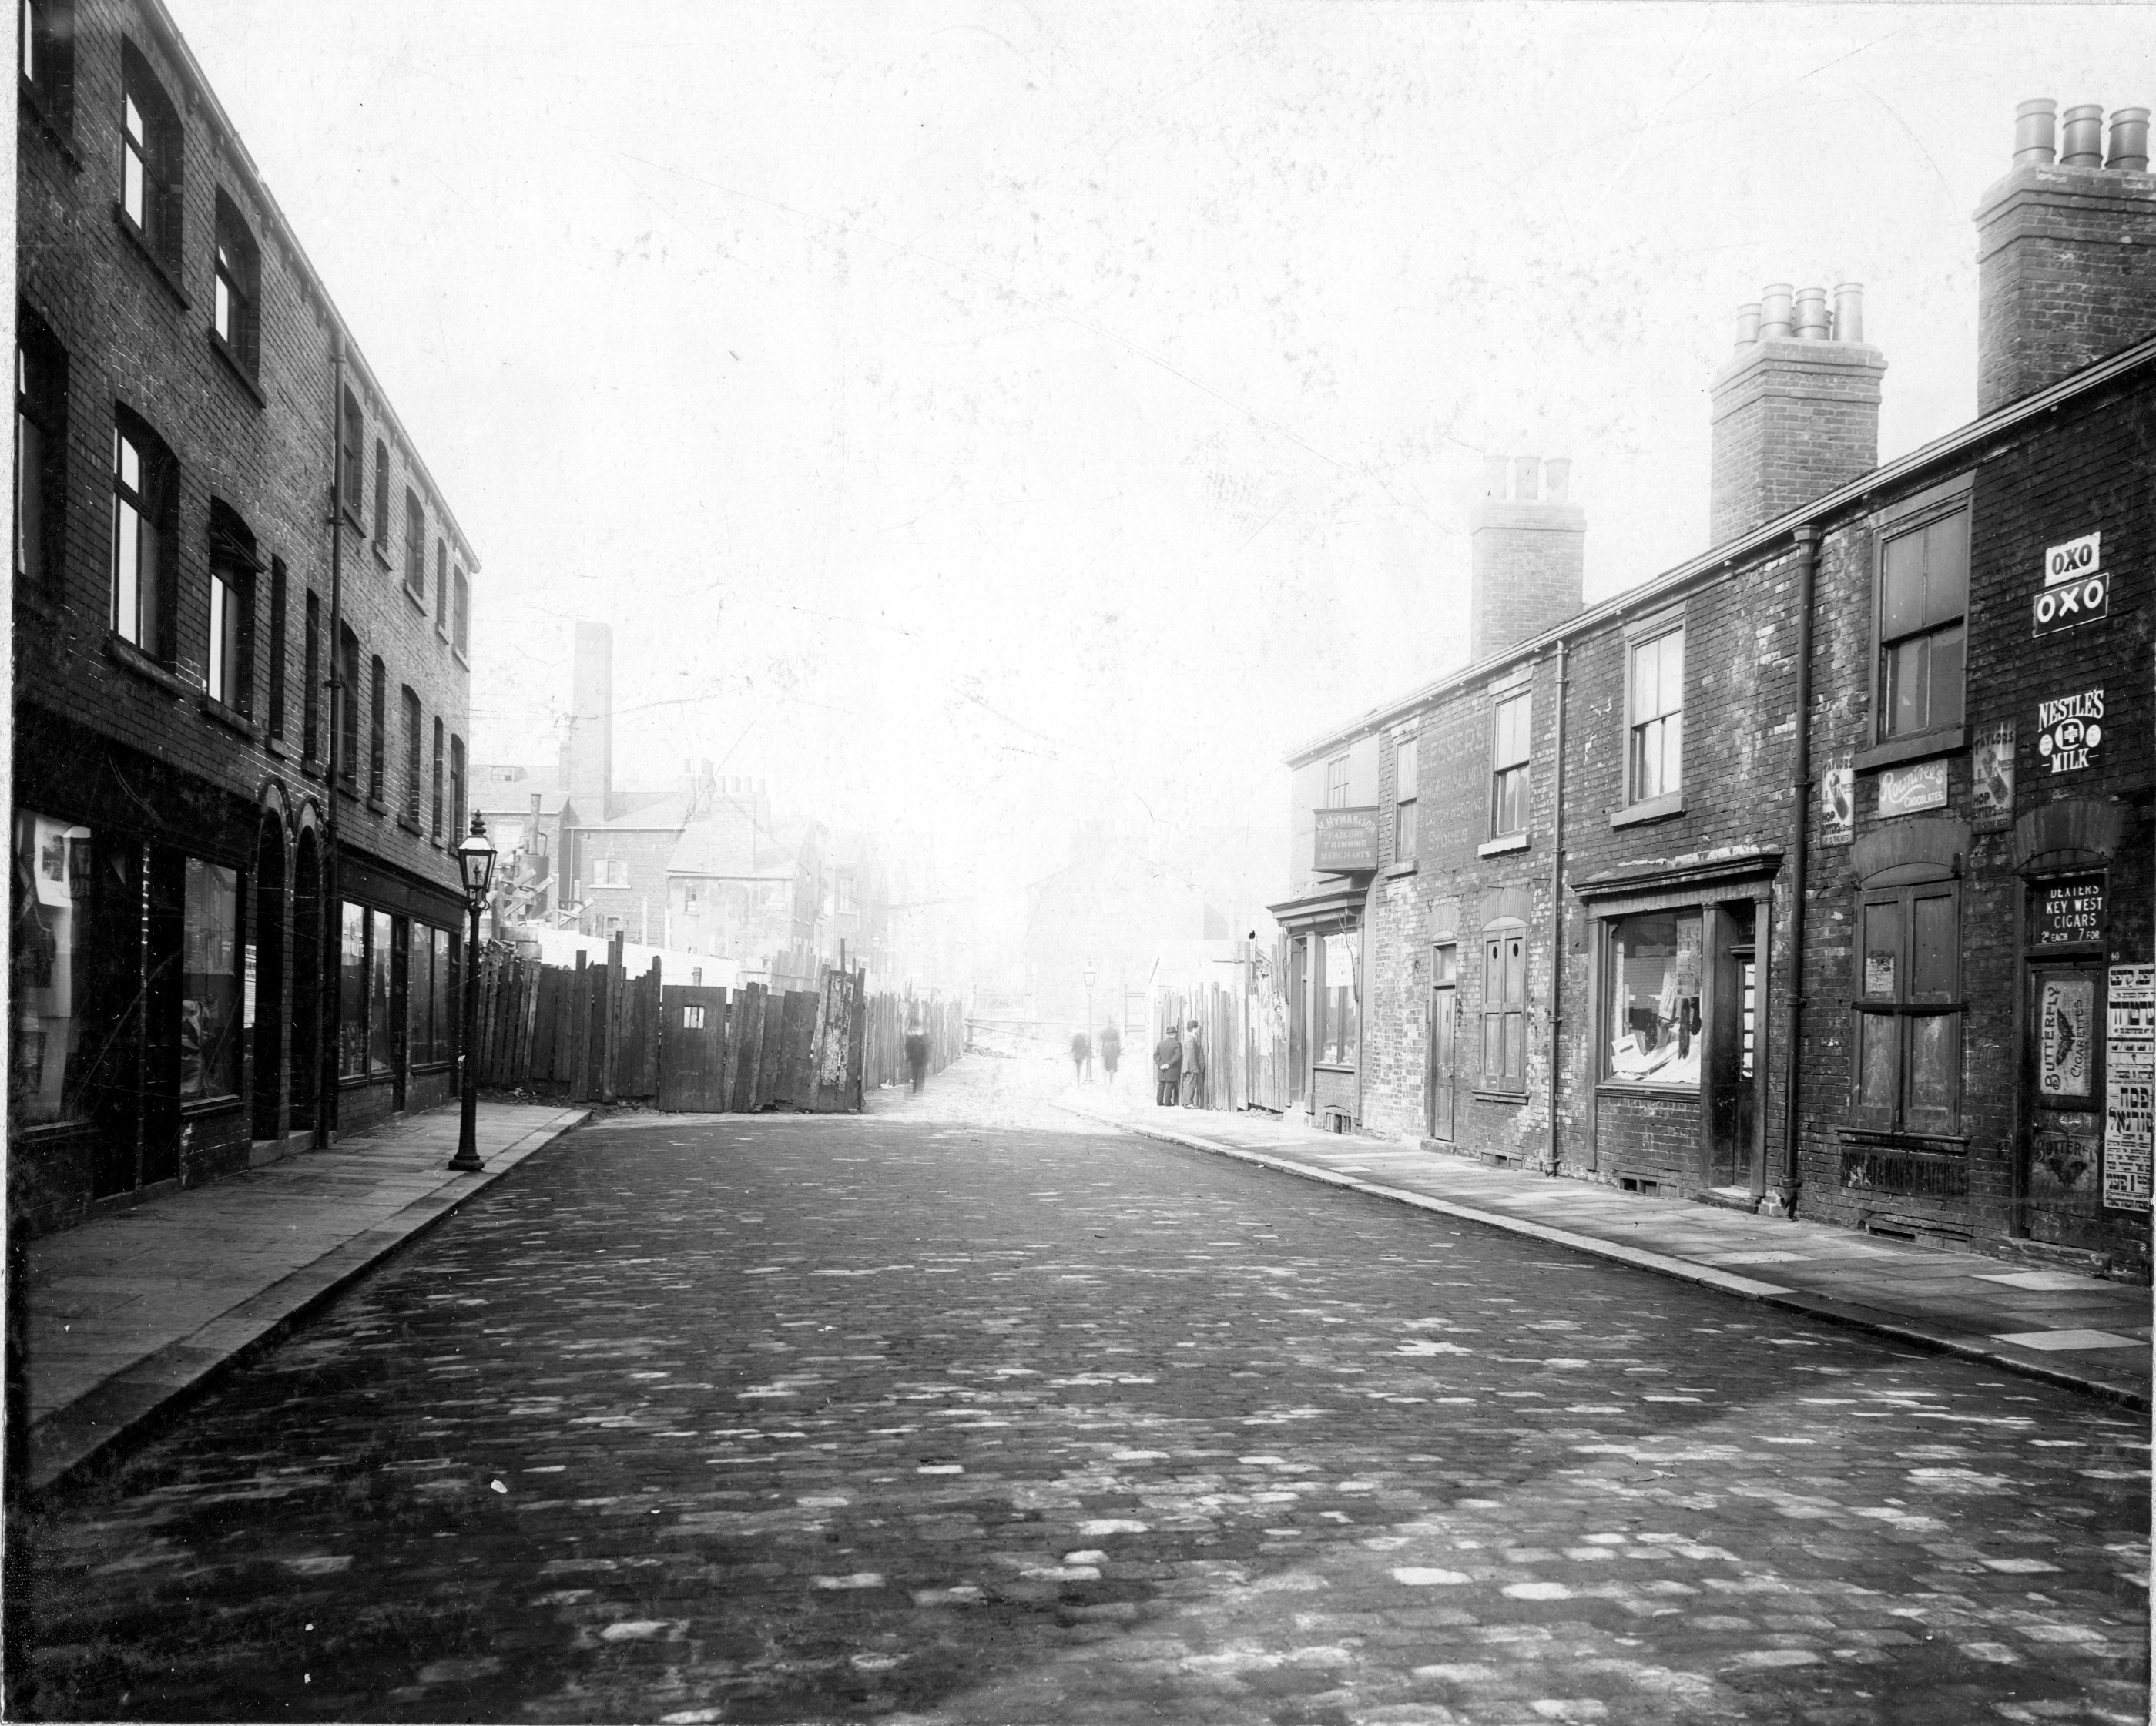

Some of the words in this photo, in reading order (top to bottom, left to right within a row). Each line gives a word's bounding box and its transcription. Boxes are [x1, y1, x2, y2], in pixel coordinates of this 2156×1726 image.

[2052, 544, 2092, 575] OXO
[2037, 579, 2104, 623] OXO
[2051, 747, 2090, 773] MILK
[1973, 791, 1990, 806] HOP
[1822, 810, 1836, 823] HOP
[1323, 840, 1366, 850] TRIMMING
[1428, 827, 1469, 851] STORES
[2047, 900, 2068, 914] KEY
[2074, 897, 2103, 912] WEST
[2054, 913, 2097, 929] CIGARS
[2051, 933, 2068, 942] EACH
[2078, 927, 2084, 940] 7
[2086, 930, 2101, 940] FOR
[2044, 986, 2061, 1091] BUTTERFLY
